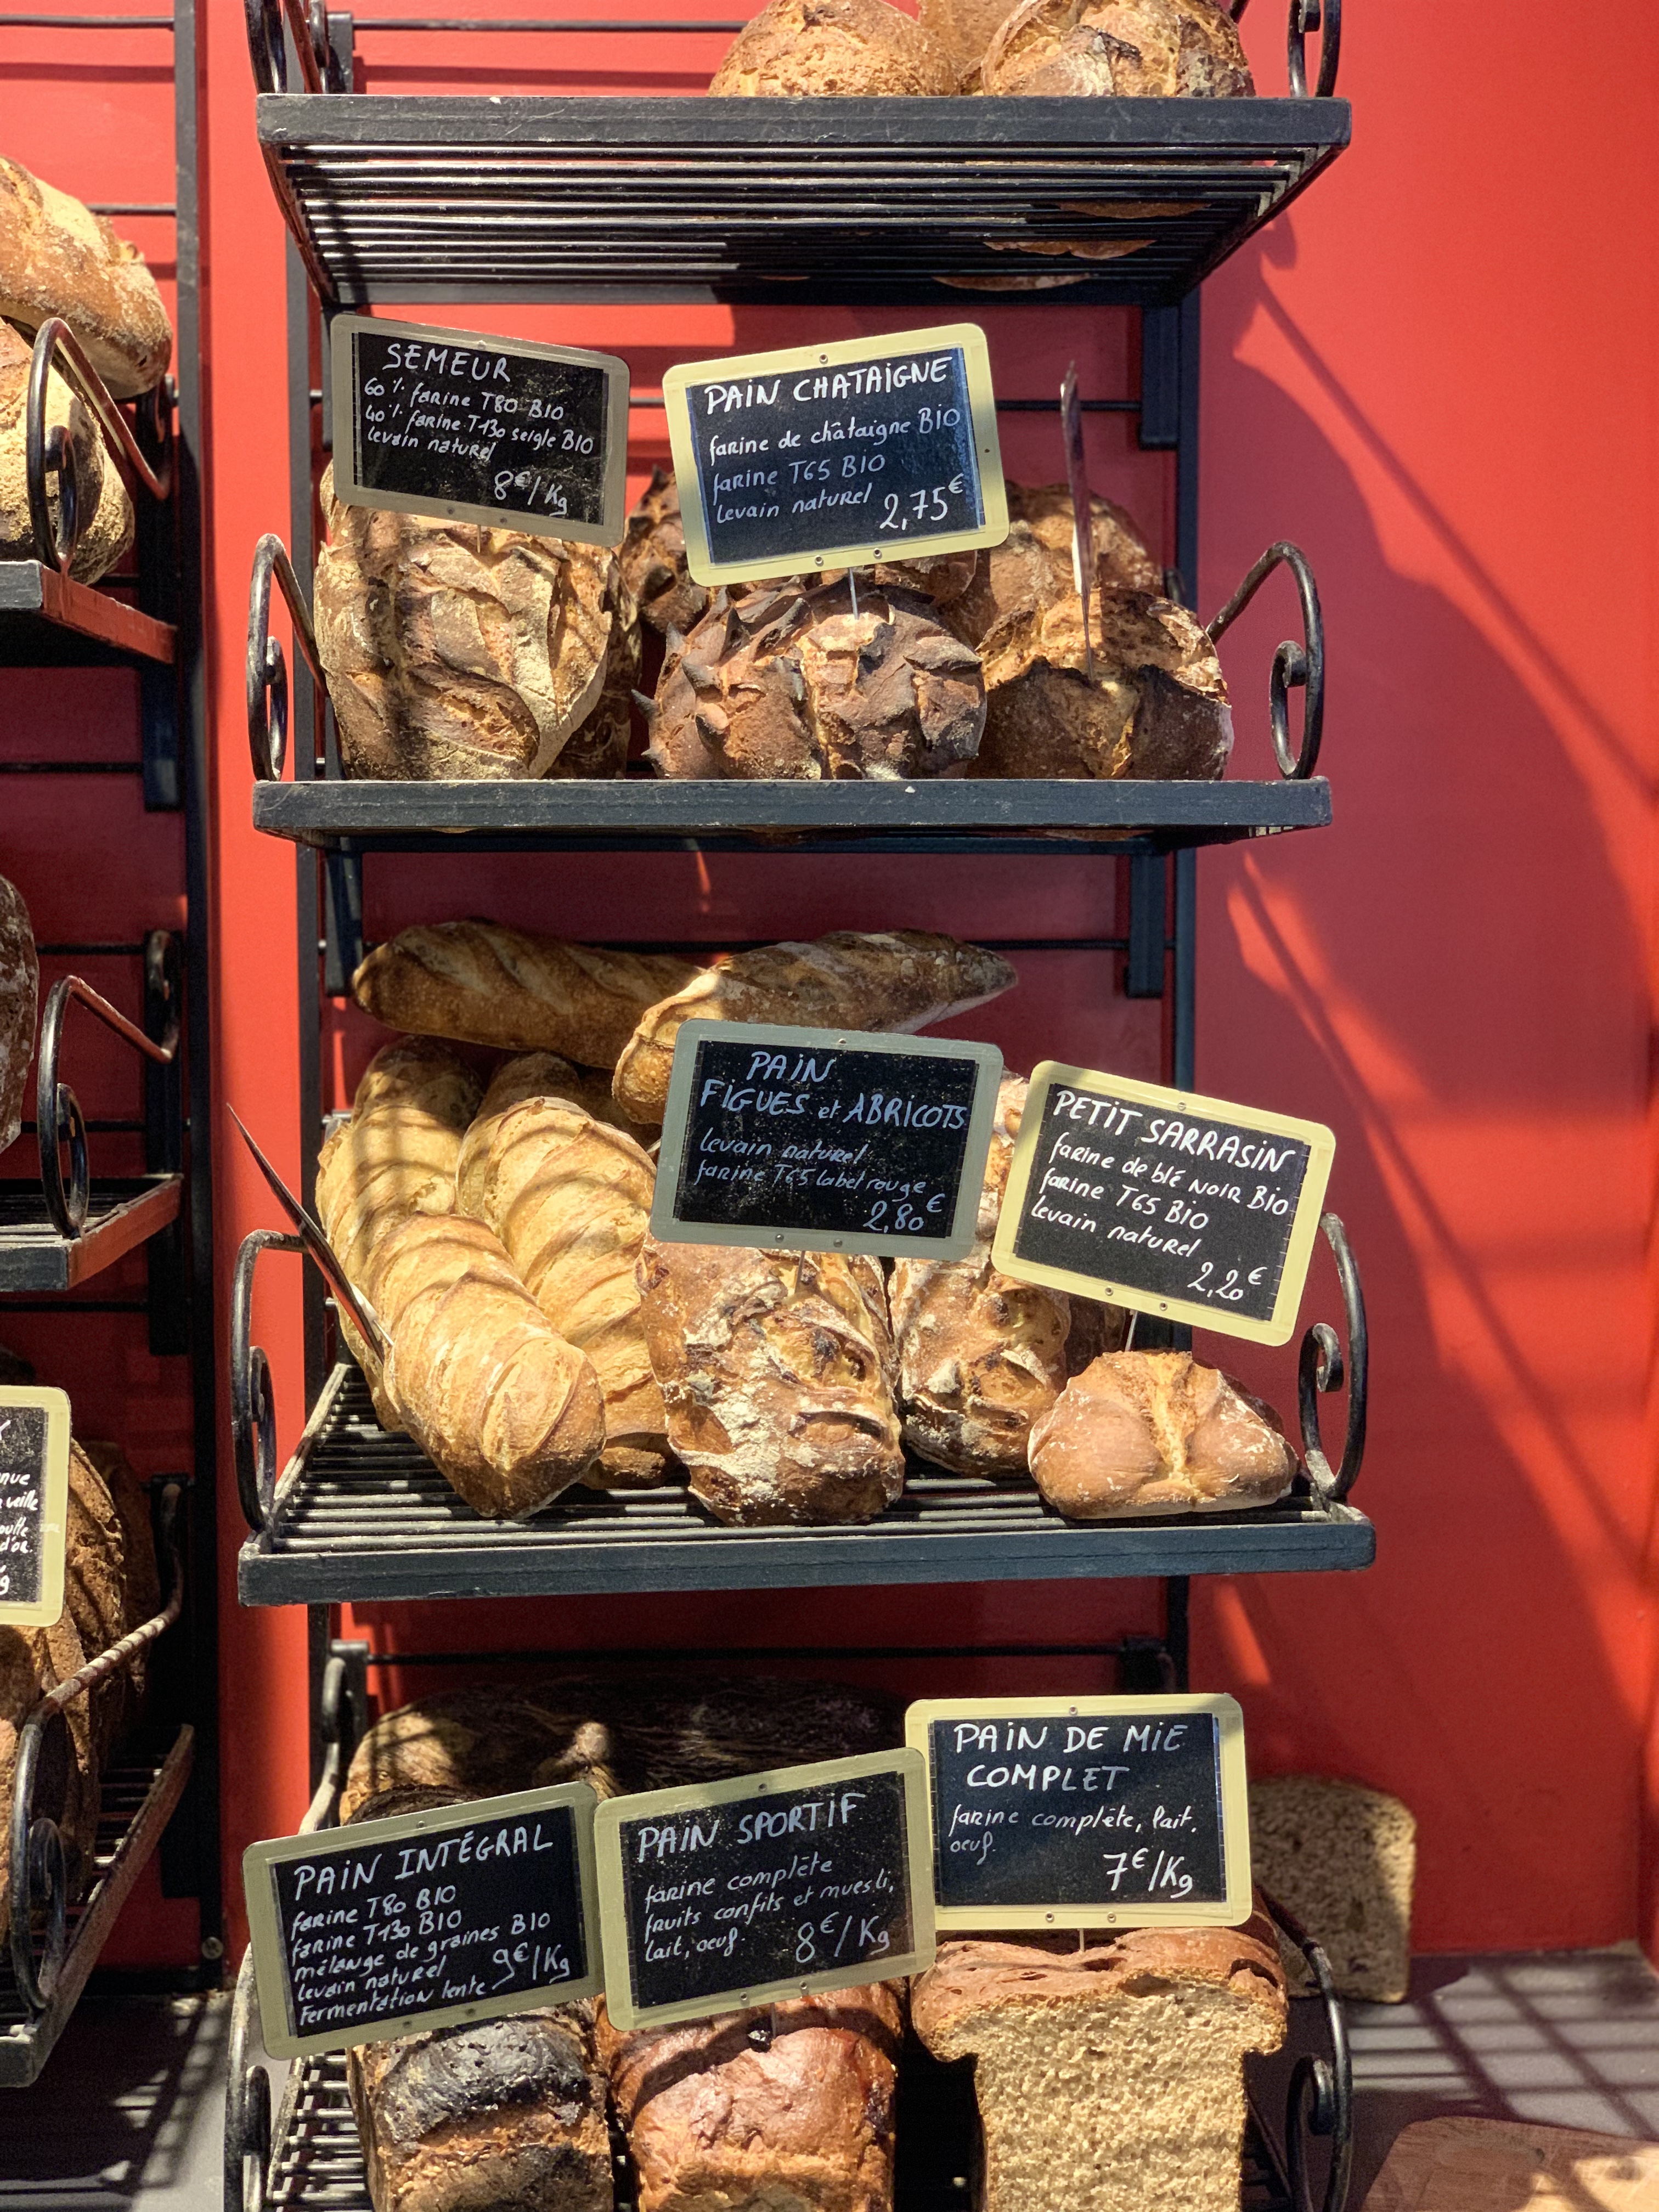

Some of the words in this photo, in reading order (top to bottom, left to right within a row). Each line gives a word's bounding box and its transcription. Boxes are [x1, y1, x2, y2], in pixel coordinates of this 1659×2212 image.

[382, 343, 511, 382] SEMEUR
[793, 357, 952, 402] CHATAIGNE
[364, 377, 385, 397] 60
[410, 382, 471, 407] farine
[481, 392, 518, 413] T80
[365, 405, 385, 422] 40
[405, 409, 461, 433] farine
[467, 414, 505, 438] T130
[512, 428, 556, 450] seigle
[367, 425, 419, 448] levain
[428, 439, 496, 462] naturel
[709, 435, 769, 465] farine
[778, 431, 801, 450] de
[811, 416, 910, 446] châtaigne
[713, 467, 778, 506] farine
[789, 459, 830, 485] T65
[716, 504, 779, 524] levain
[792, 482, 872, 514] naturel
[700, 1079, 810, 1116] FIGUES
[818, 1105, 839, 1120] et
[843, 1093, 968, 1130] ABRICOTS
[1053, 1090, 1143, 1136] PETIT
[699, 1127, 771, 1155] levain
[781, 1141, 870, 1165] naturel
[1053, 1132, 1114, 1169] farine
[1122, 1157, 1148, 1178] de
[1151, 1163, 1186, 1188] blé
[694, 1159, 766, 1186] farine
[774, 1164, 815, 1186] T65
[816, 1170, 865, 1190] label
[867, 1178, 927, 1202] rouge
[1042, 1167, 1105, 1199] farine
[1115, 1184, 1161, 1215] T65
[1031, 1195, 1096, 1233] levain
[1108, 1223, 1201, 1257] naturel
[0, 1471, 30, 1486] nue
[6, 1489, 38, 1511] veille
[0, 1517, 29, 1537] outte
[1063, 1726, 1109, 1753] DE
[967, 1763, 1130, 1791] COMPLET
[737, 1793, 866, 1845] SPORTIF
[948, 1803, 1018, 1837] farine
[394, 1823, 553, 1881] INTÉGRAL
[291, 1906, 358, 1941] farine
[366, 1893, 406, 1920] T80
[645, 1877, 715, 1913] farine
[645, 1910, 701, 1944] fruits
[714, 1892, 781, 1925] confits
[793, 1886, 811, 1907] et
[292, 1932, 356, 1967] farine
[363, 1920, 410, 1946] T130
[295, 1952, 385, 1983] mélange
[396, 1944, 419, 1961] de
[428, 1925, 499, 1960] graines
[645, 1940, 690, 1962] lait,
[298, 1976, 355, 2002] levain
[365, 1957, 447, 1989] naturel
[441, 1978, 486, 2000] lente
